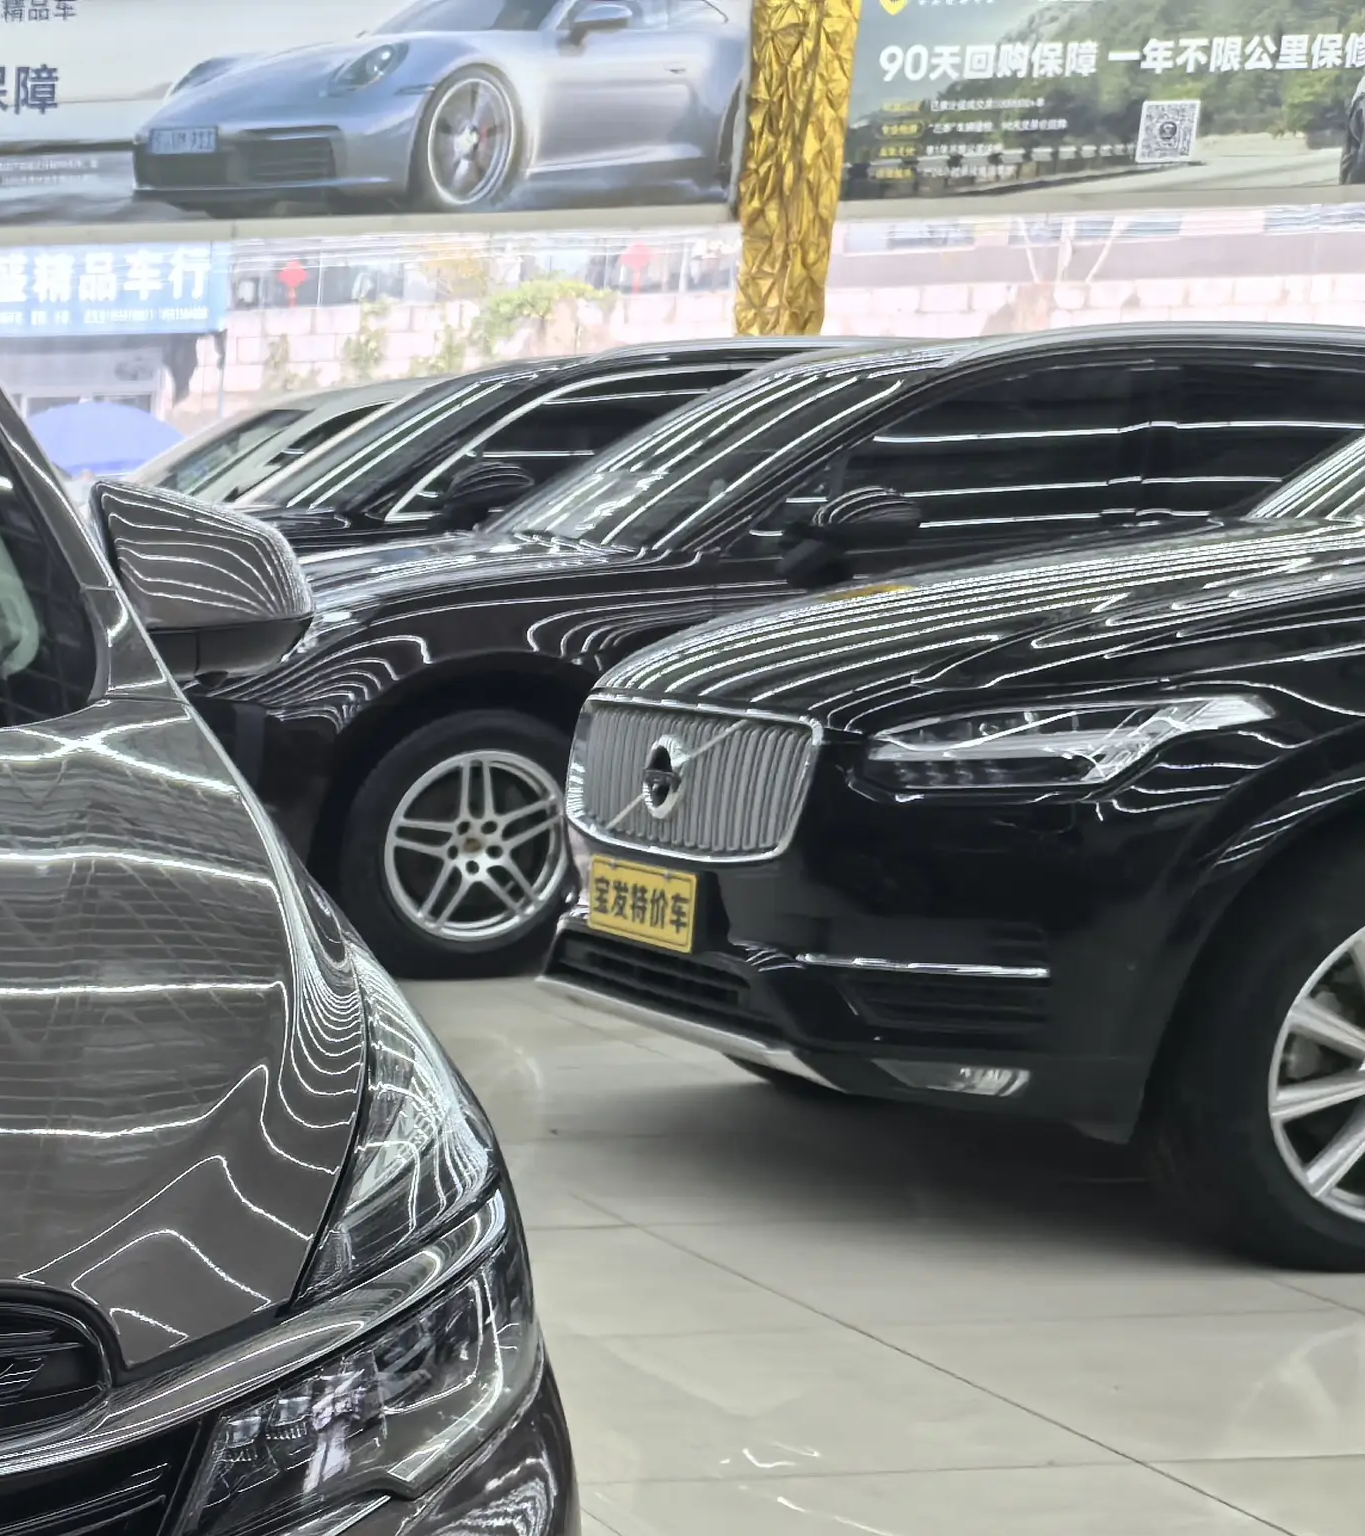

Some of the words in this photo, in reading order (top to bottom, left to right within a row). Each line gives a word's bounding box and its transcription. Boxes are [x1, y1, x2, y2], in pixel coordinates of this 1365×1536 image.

[879, 39, 1099, 82] 90天回购保障
[594, 877, 690, 934] 宝发特价车
